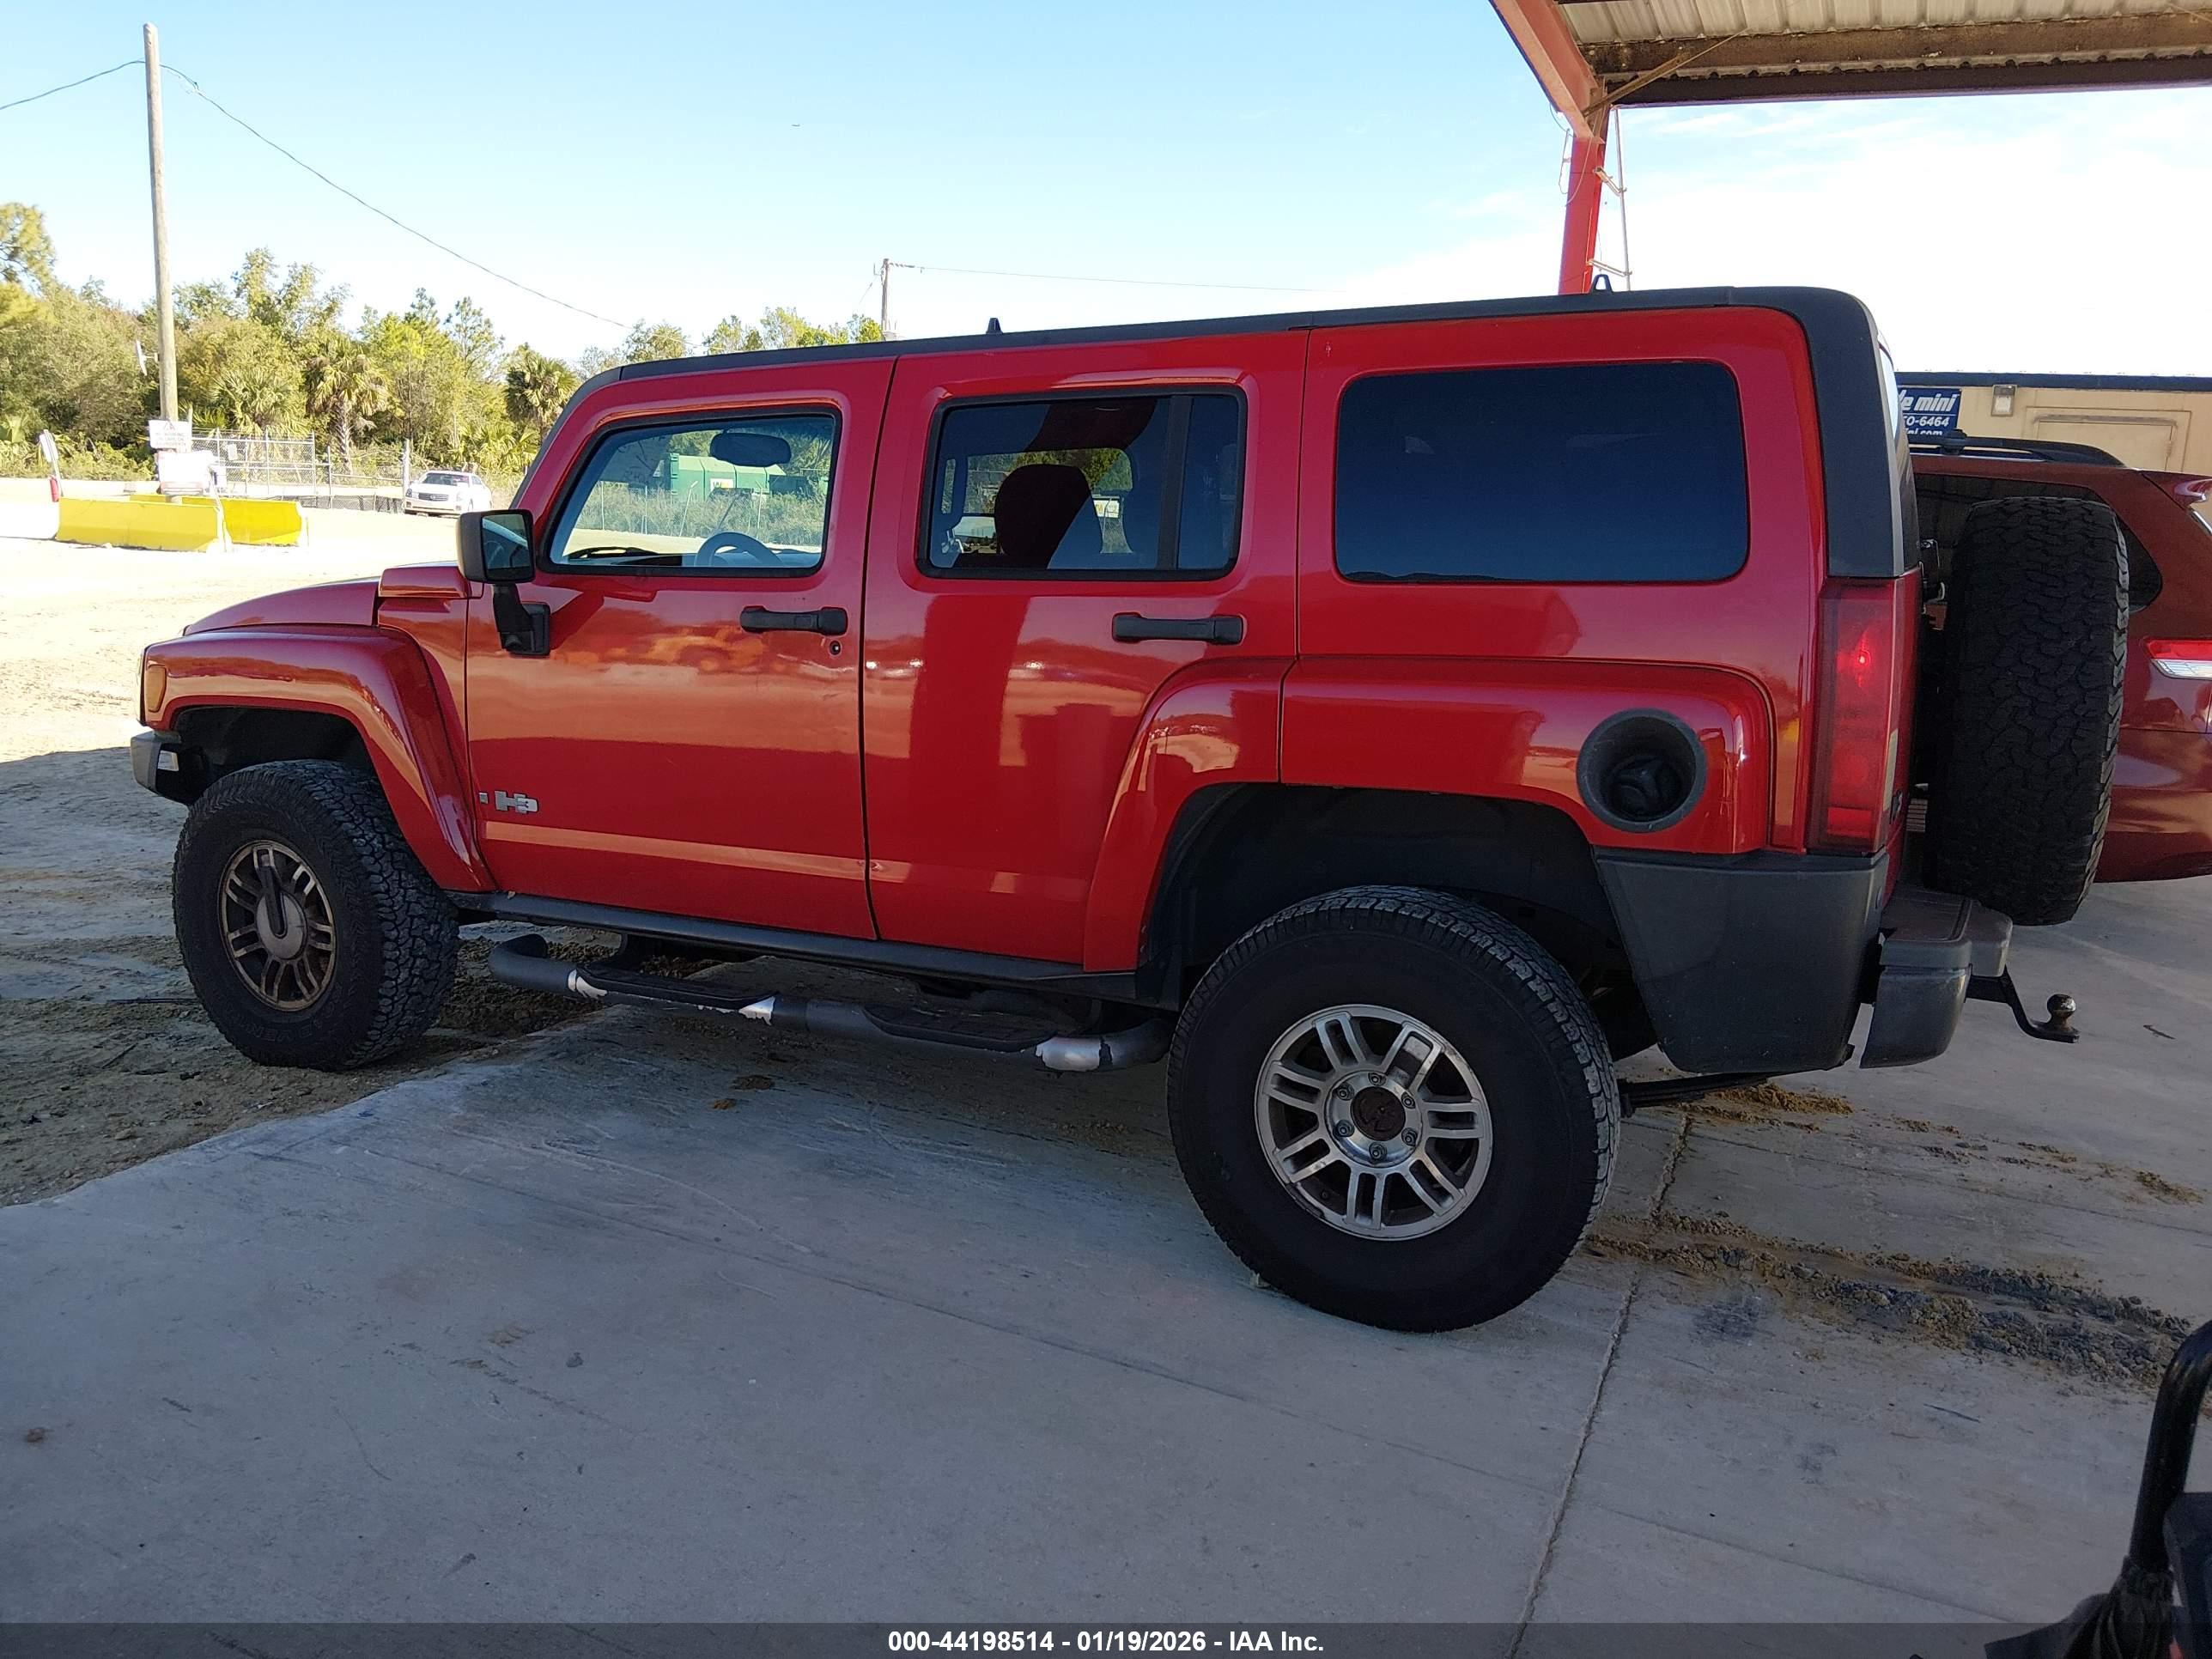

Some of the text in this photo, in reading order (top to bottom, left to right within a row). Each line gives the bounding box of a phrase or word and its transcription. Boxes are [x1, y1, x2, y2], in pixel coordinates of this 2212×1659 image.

[1913, 393, 1959, 411] mini
[1904, 416, 1949, 427] 0-6464
[494, 790, 538, 814] H3
